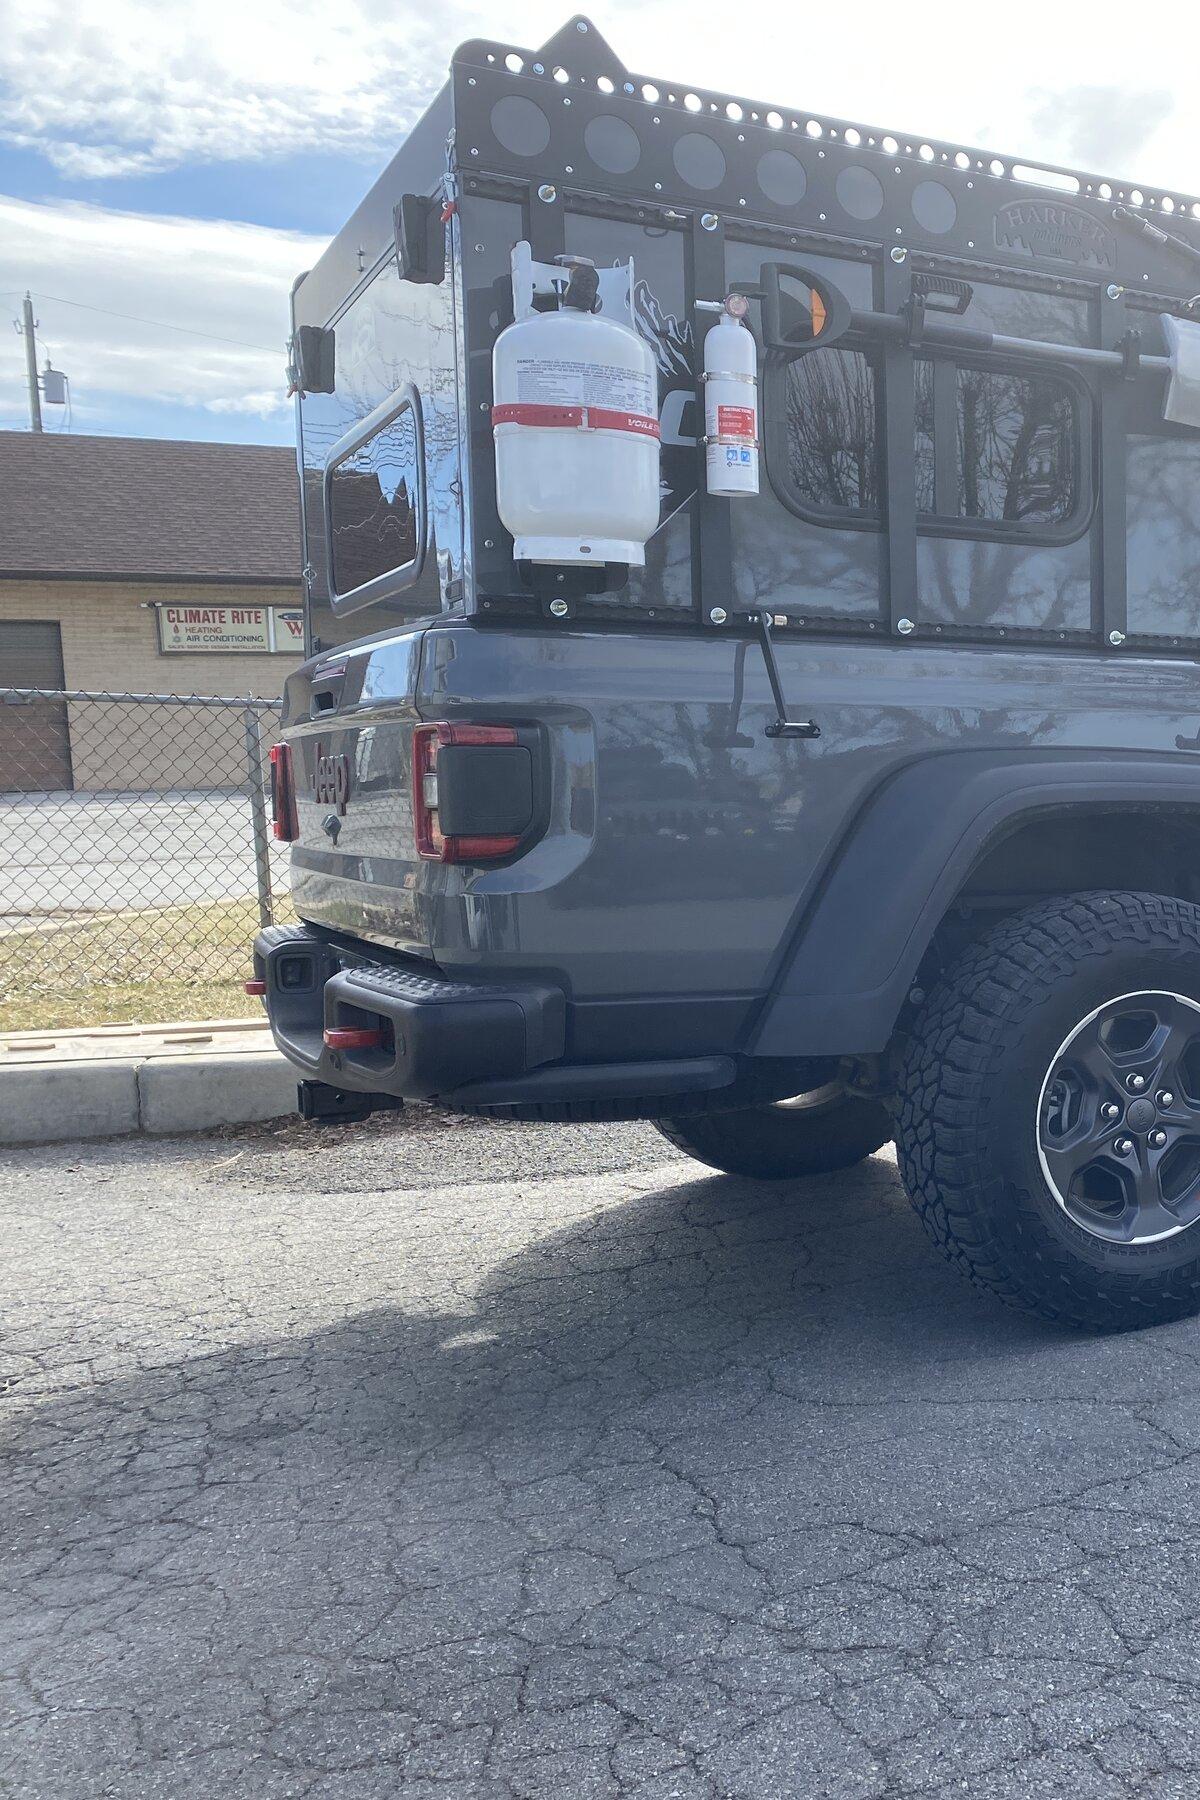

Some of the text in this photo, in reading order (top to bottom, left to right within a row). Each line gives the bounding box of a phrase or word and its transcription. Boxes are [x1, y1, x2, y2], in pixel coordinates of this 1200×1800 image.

[1005, 206, 1106, 245] HARKER
[166, 609, 262, 625] CLIMATE RITE
[185, 626, 223, 634] HEATING
[202, 635, 264, 643] CONDITIONING
[309, 742, 350, 816] Jeep
